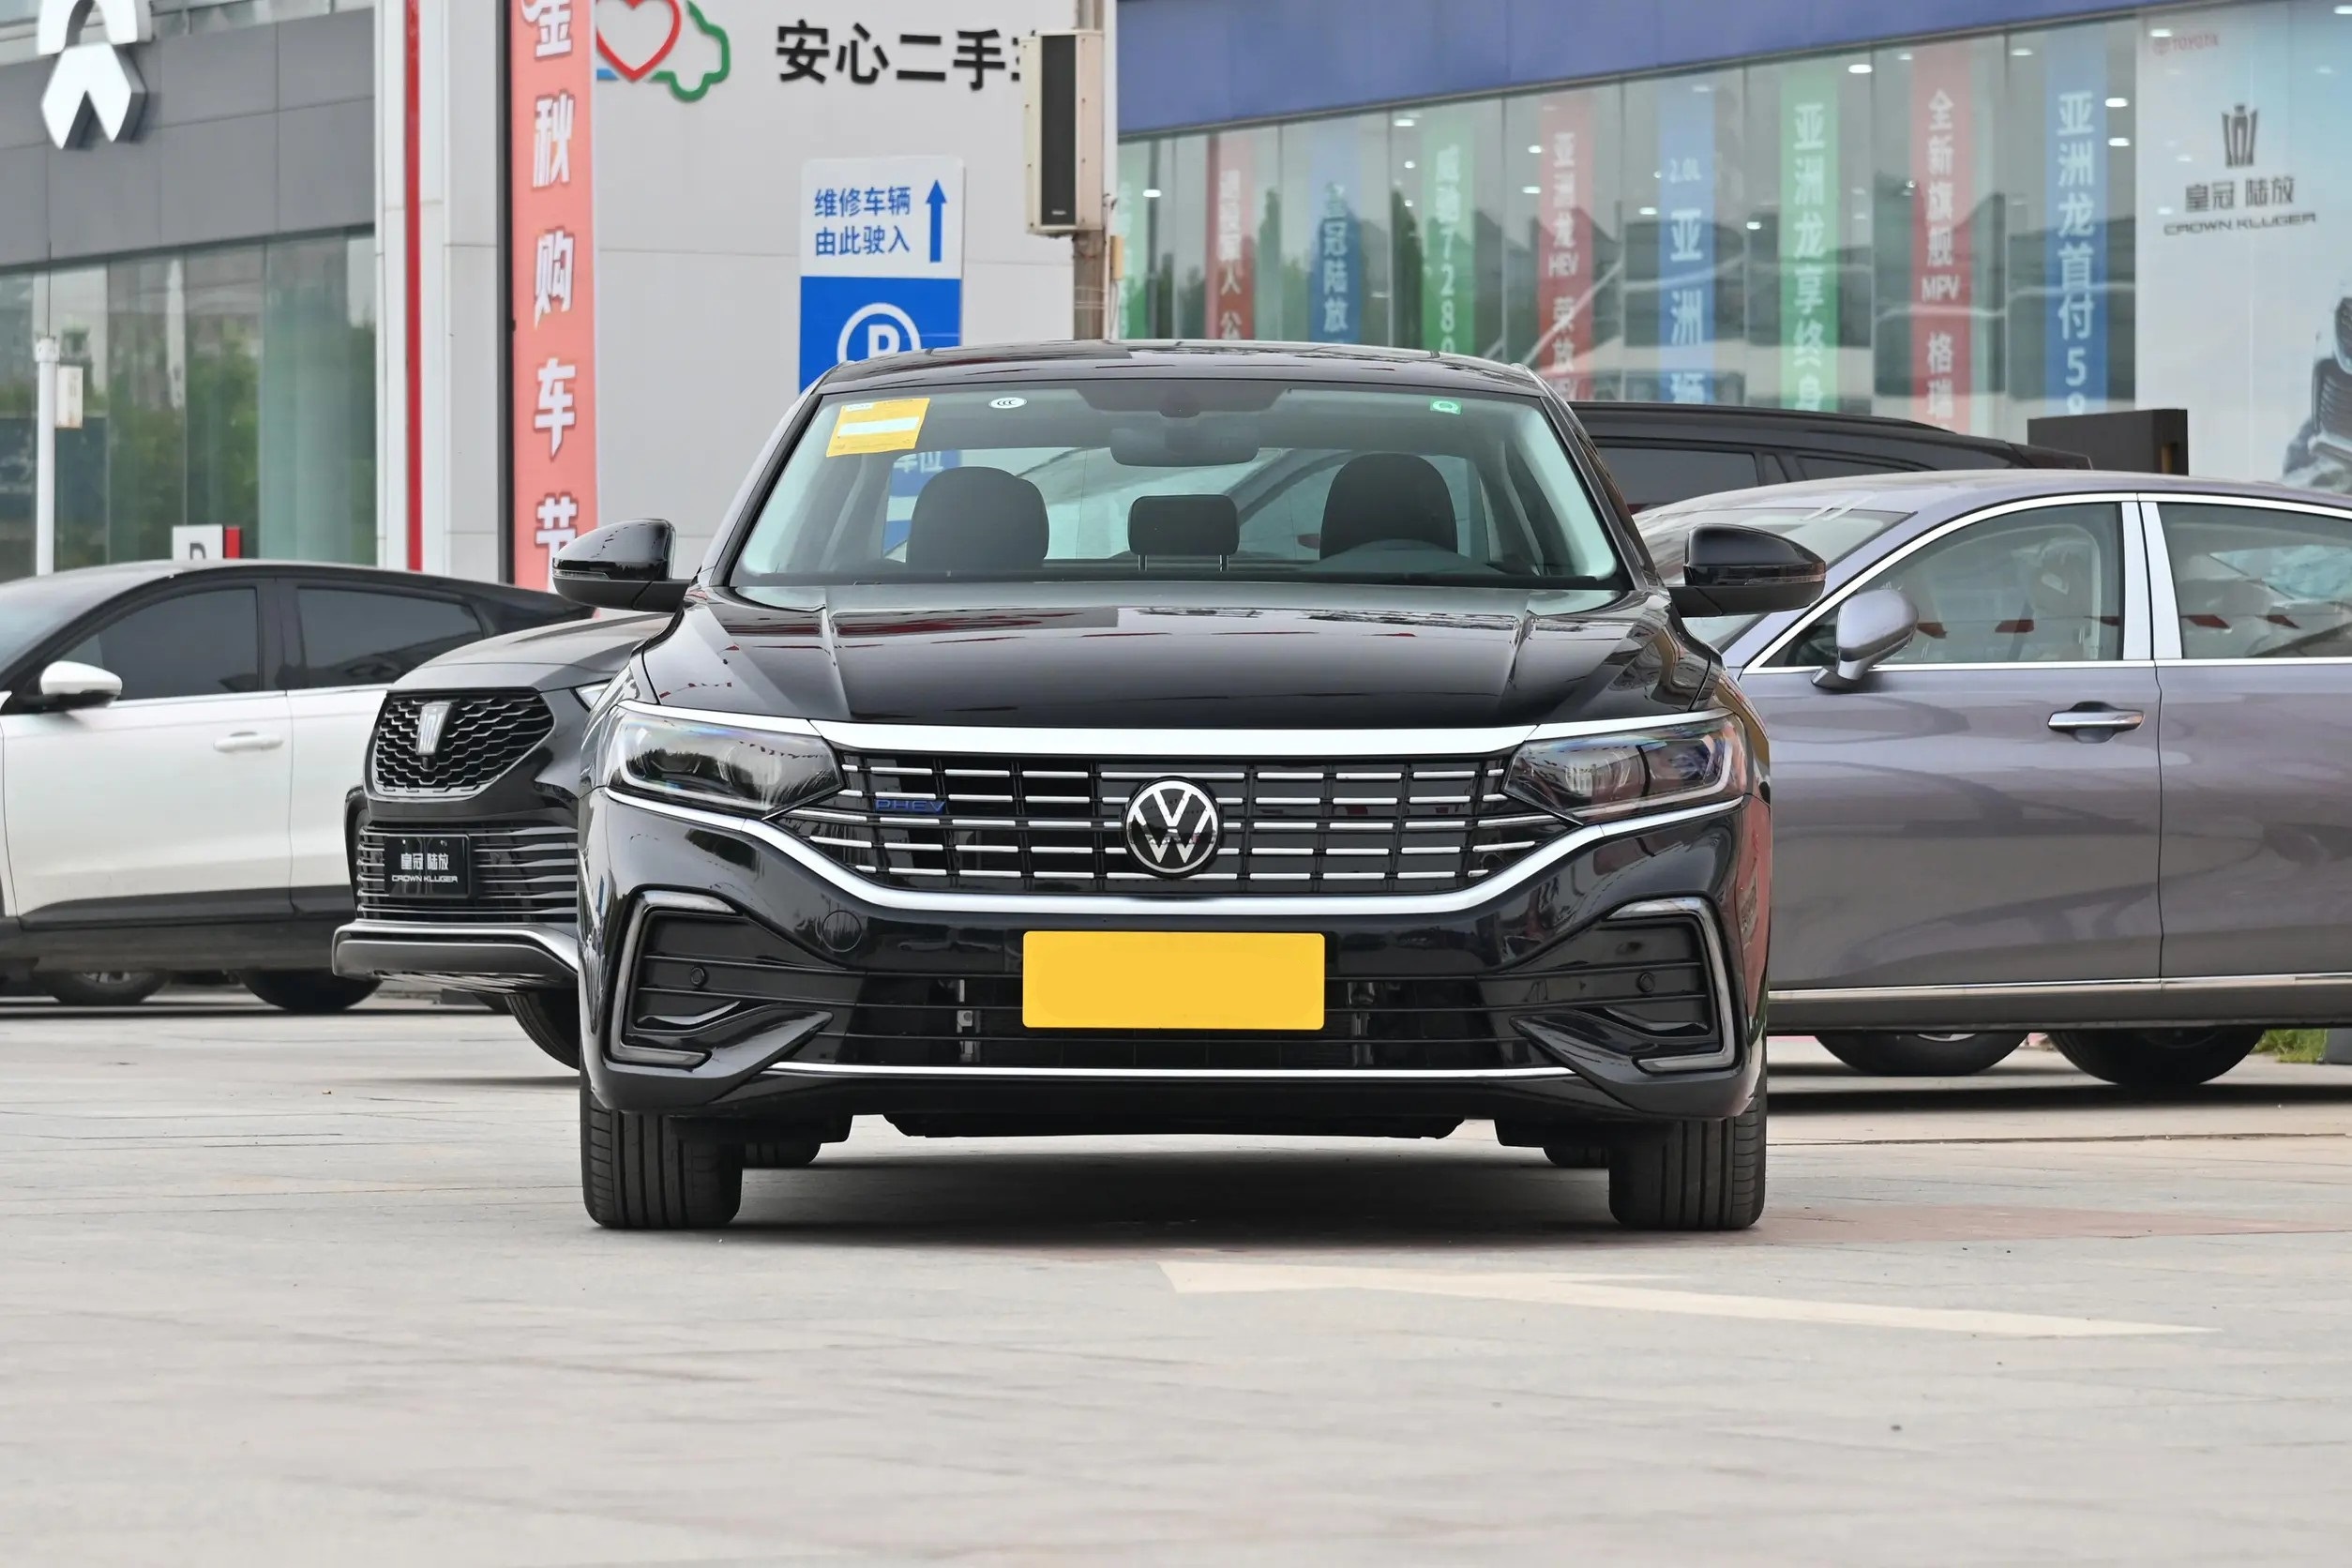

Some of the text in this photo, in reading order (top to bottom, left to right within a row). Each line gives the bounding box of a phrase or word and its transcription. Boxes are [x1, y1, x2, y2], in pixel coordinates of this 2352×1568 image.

[776, 19, 1020, 91] 安心二手
[814, 186, 912, 219] 维修车辆
[2185, 175, 2295, 213] 皇冠 陆放
[2164, 212, 2316, 236] CROWN KLUGER
[815, 225, 911, 256] 由此驶入
[521, 0, 578, 593] 金秋购车节
[867, 324, 900, 359] P
[875, 799, 946, 813] PHEV
[401, 852, 449, 870] 皇冠 陆放
[391, 874, 459, 883] CROWN KLUGER
